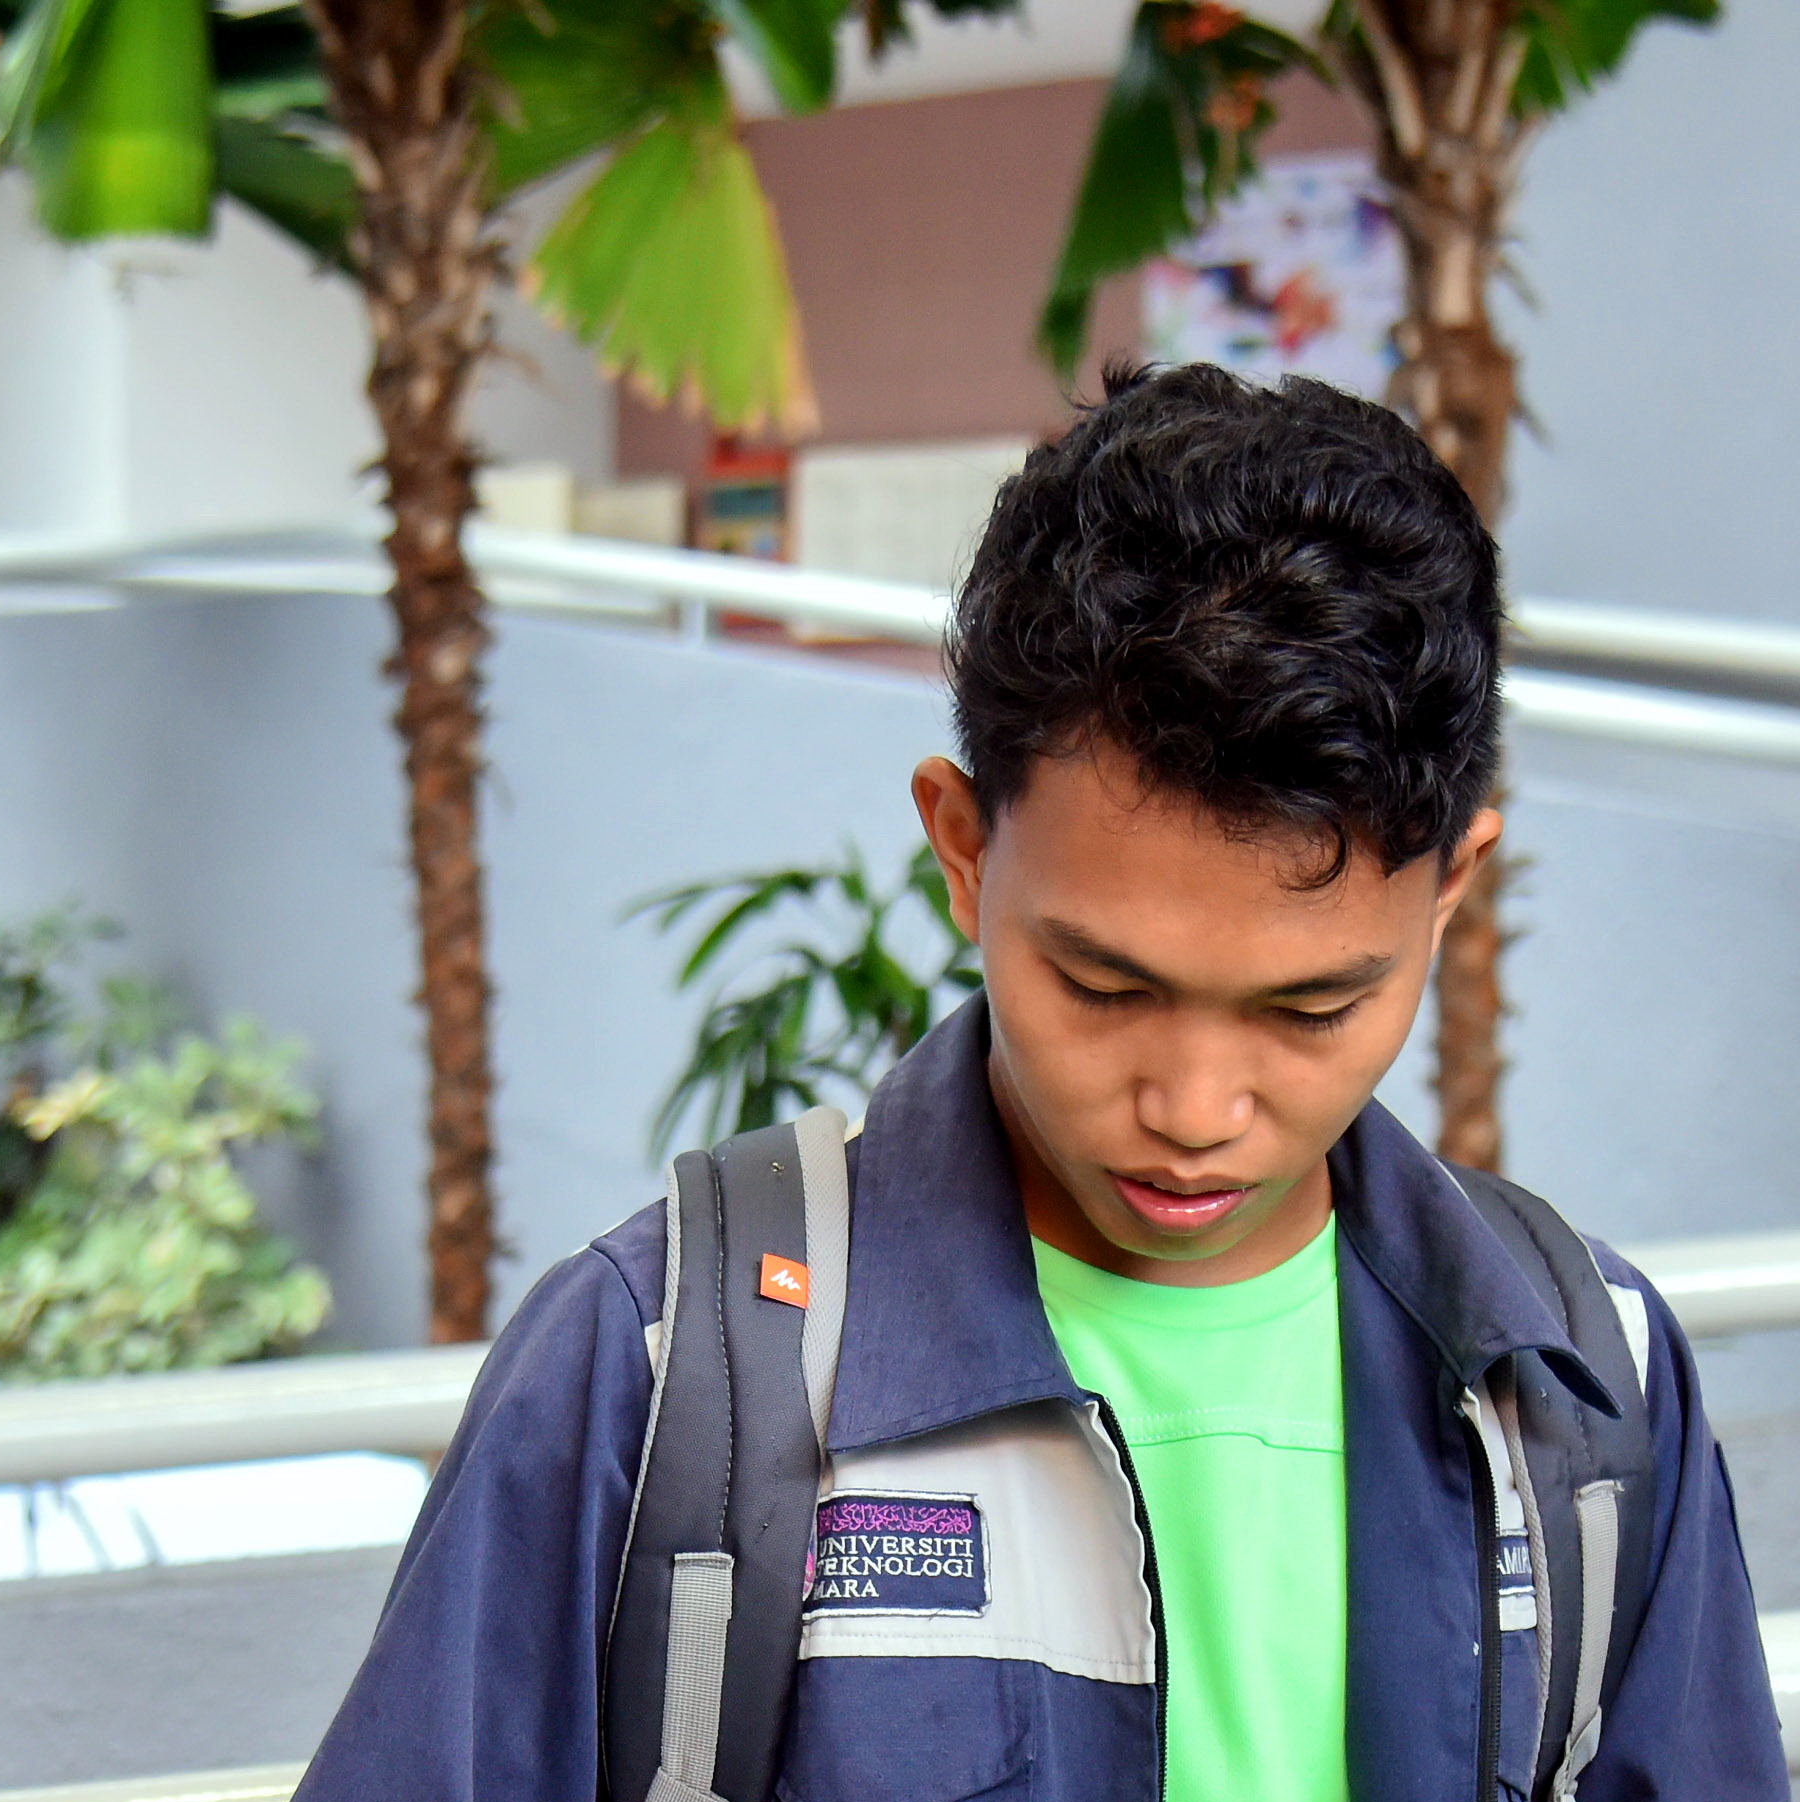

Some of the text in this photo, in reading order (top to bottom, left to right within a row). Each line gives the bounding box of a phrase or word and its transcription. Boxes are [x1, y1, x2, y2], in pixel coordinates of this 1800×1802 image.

[819, 1535, 974, 1558] UNIVERSITI
[817, 1556, 974, 1578] TEKNOLOGI
[814, 1579, 880, 1600] MARA
